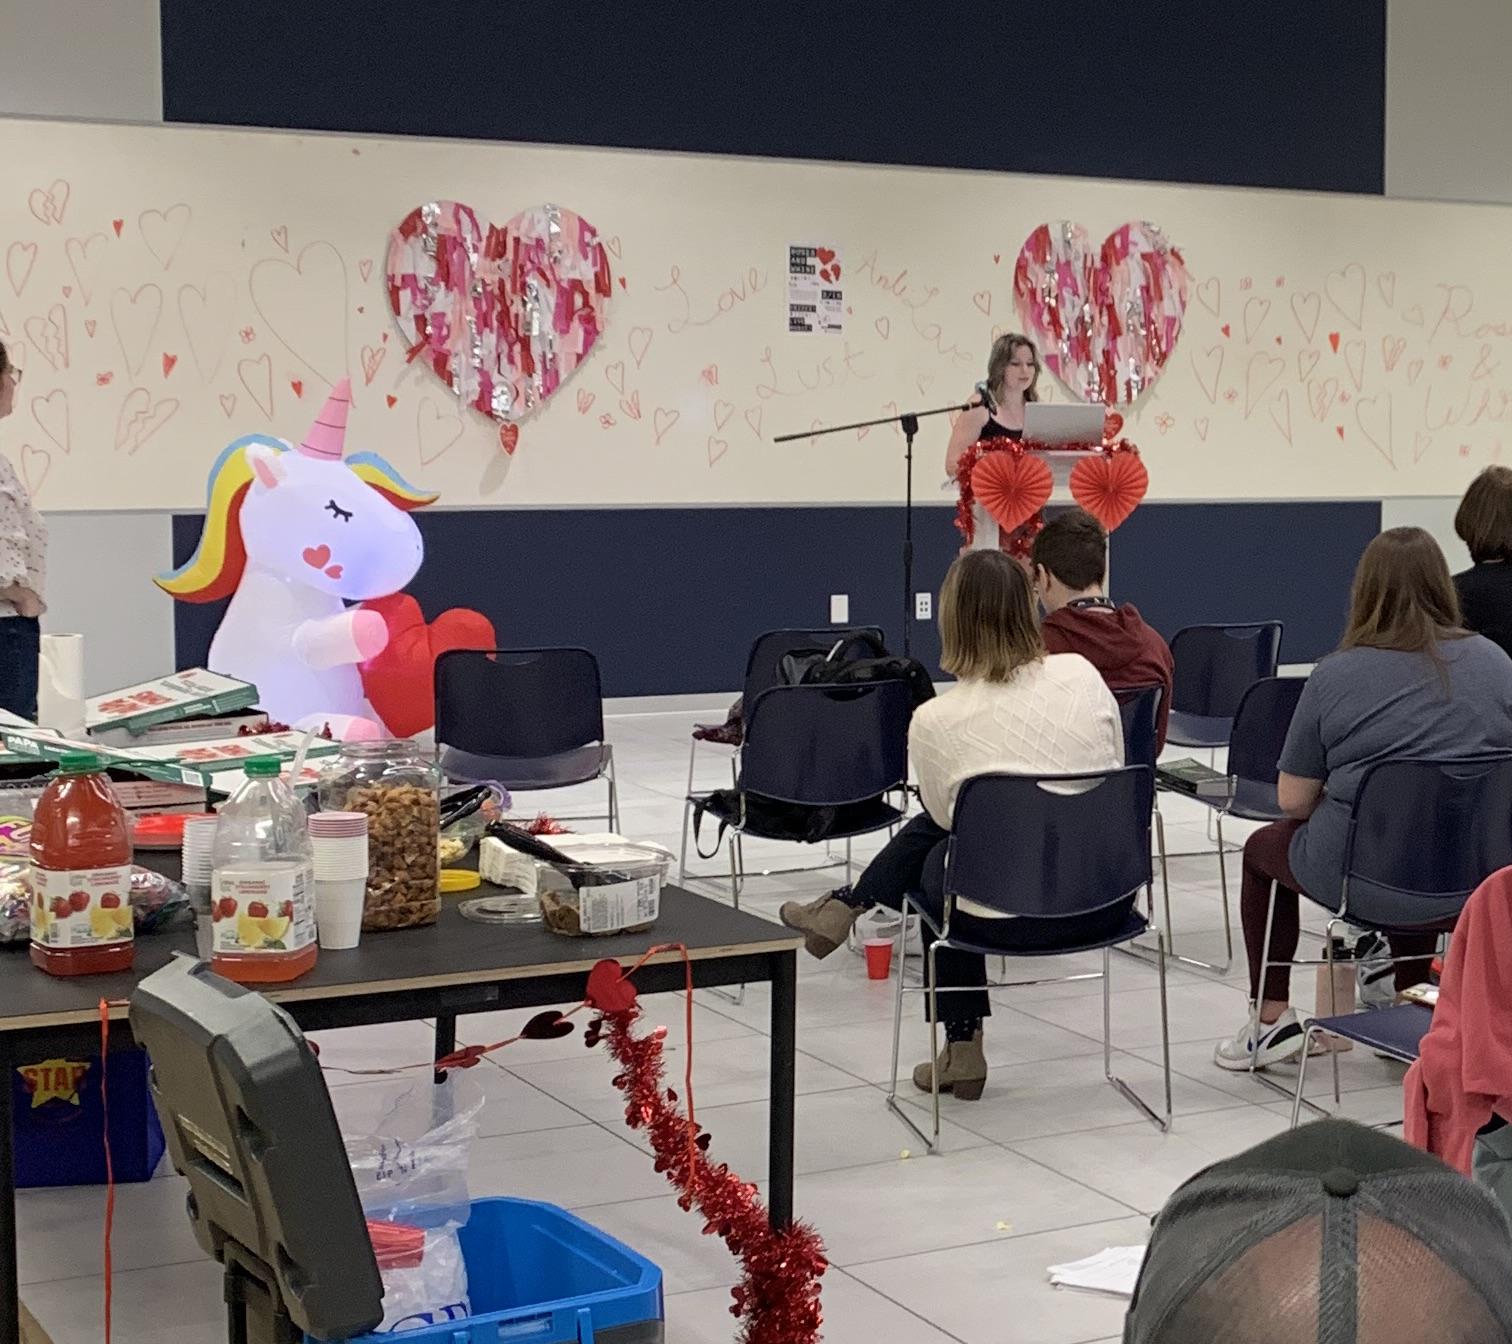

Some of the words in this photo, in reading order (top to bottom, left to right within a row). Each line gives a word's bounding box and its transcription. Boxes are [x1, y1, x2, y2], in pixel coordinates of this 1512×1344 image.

[654, 264, 767, 334] Love
[756, 342, 875, 400] Lust
[1471, 343, 1500, 380] &
[7, 736, 38, 748] PAPA
